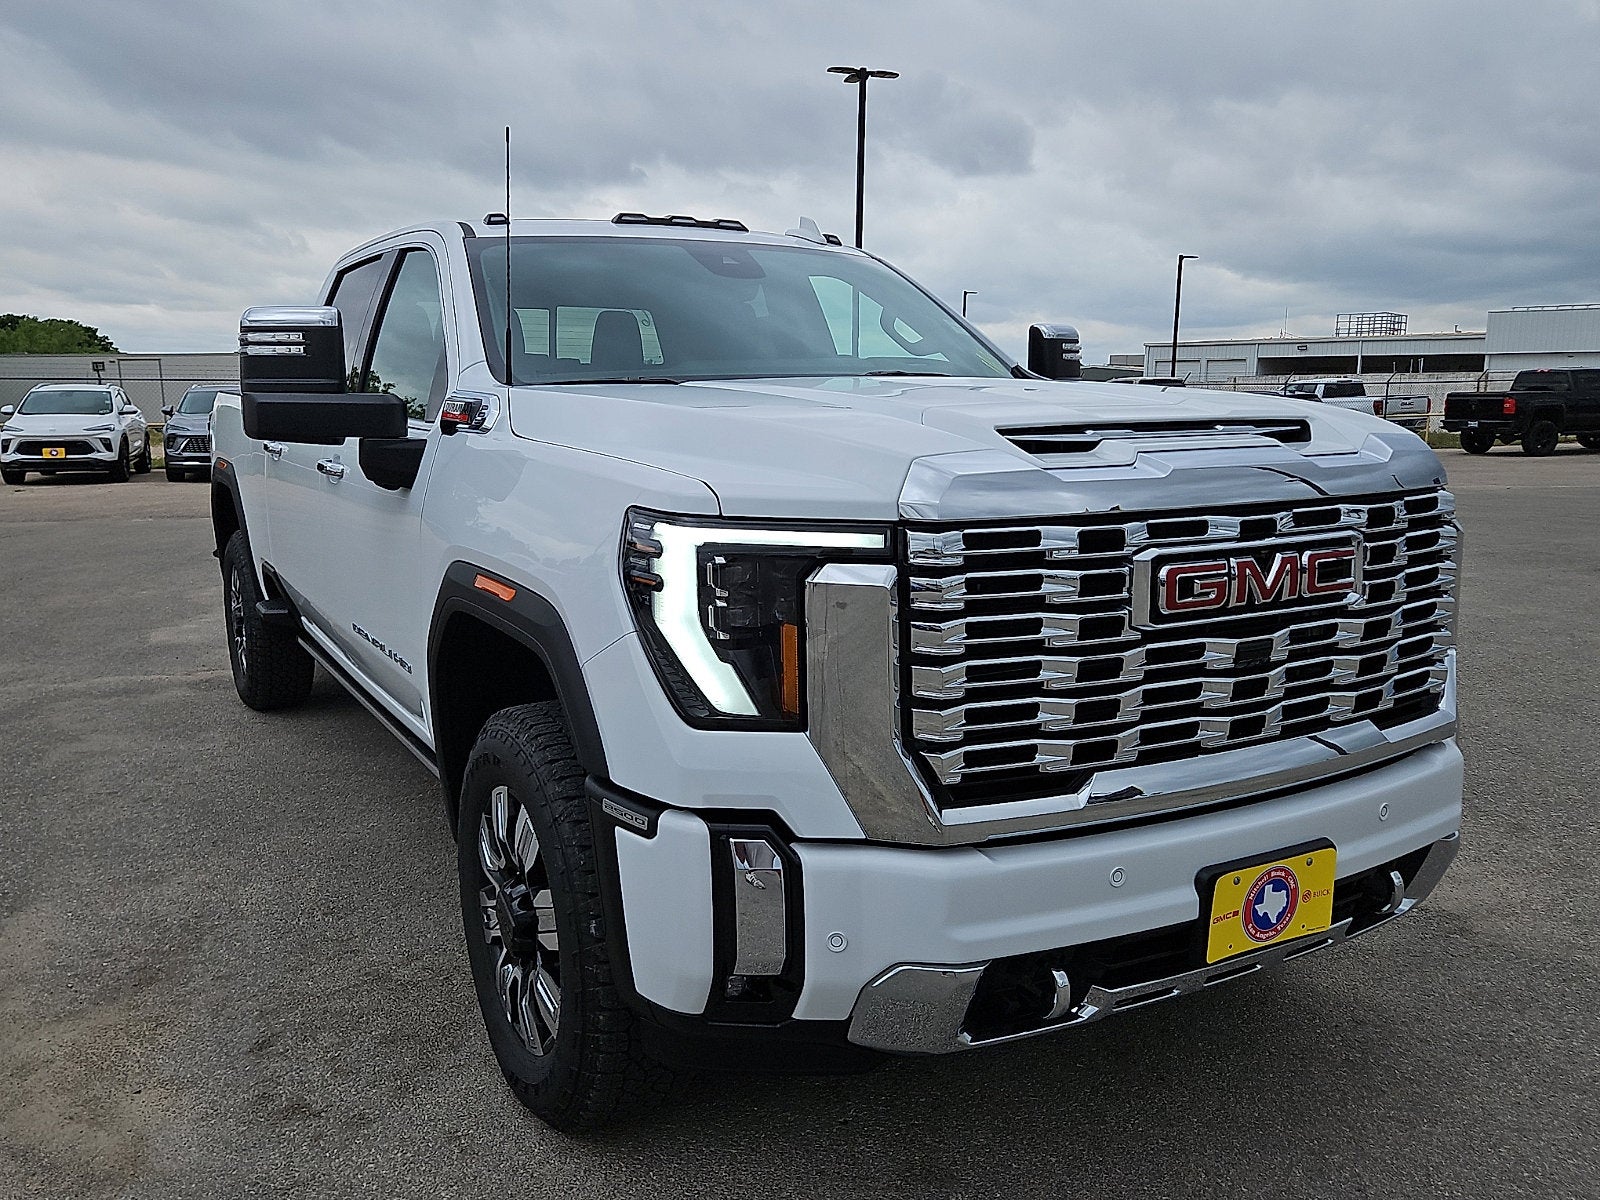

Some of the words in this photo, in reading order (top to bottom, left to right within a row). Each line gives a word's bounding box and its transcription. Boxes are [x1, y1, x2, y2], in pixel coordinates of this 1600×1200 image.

[1158, 550, 1356, 614] GMC
[1312, 889, 1330, 898] BUICK
[1212, 911, 1233, 925] GMC
